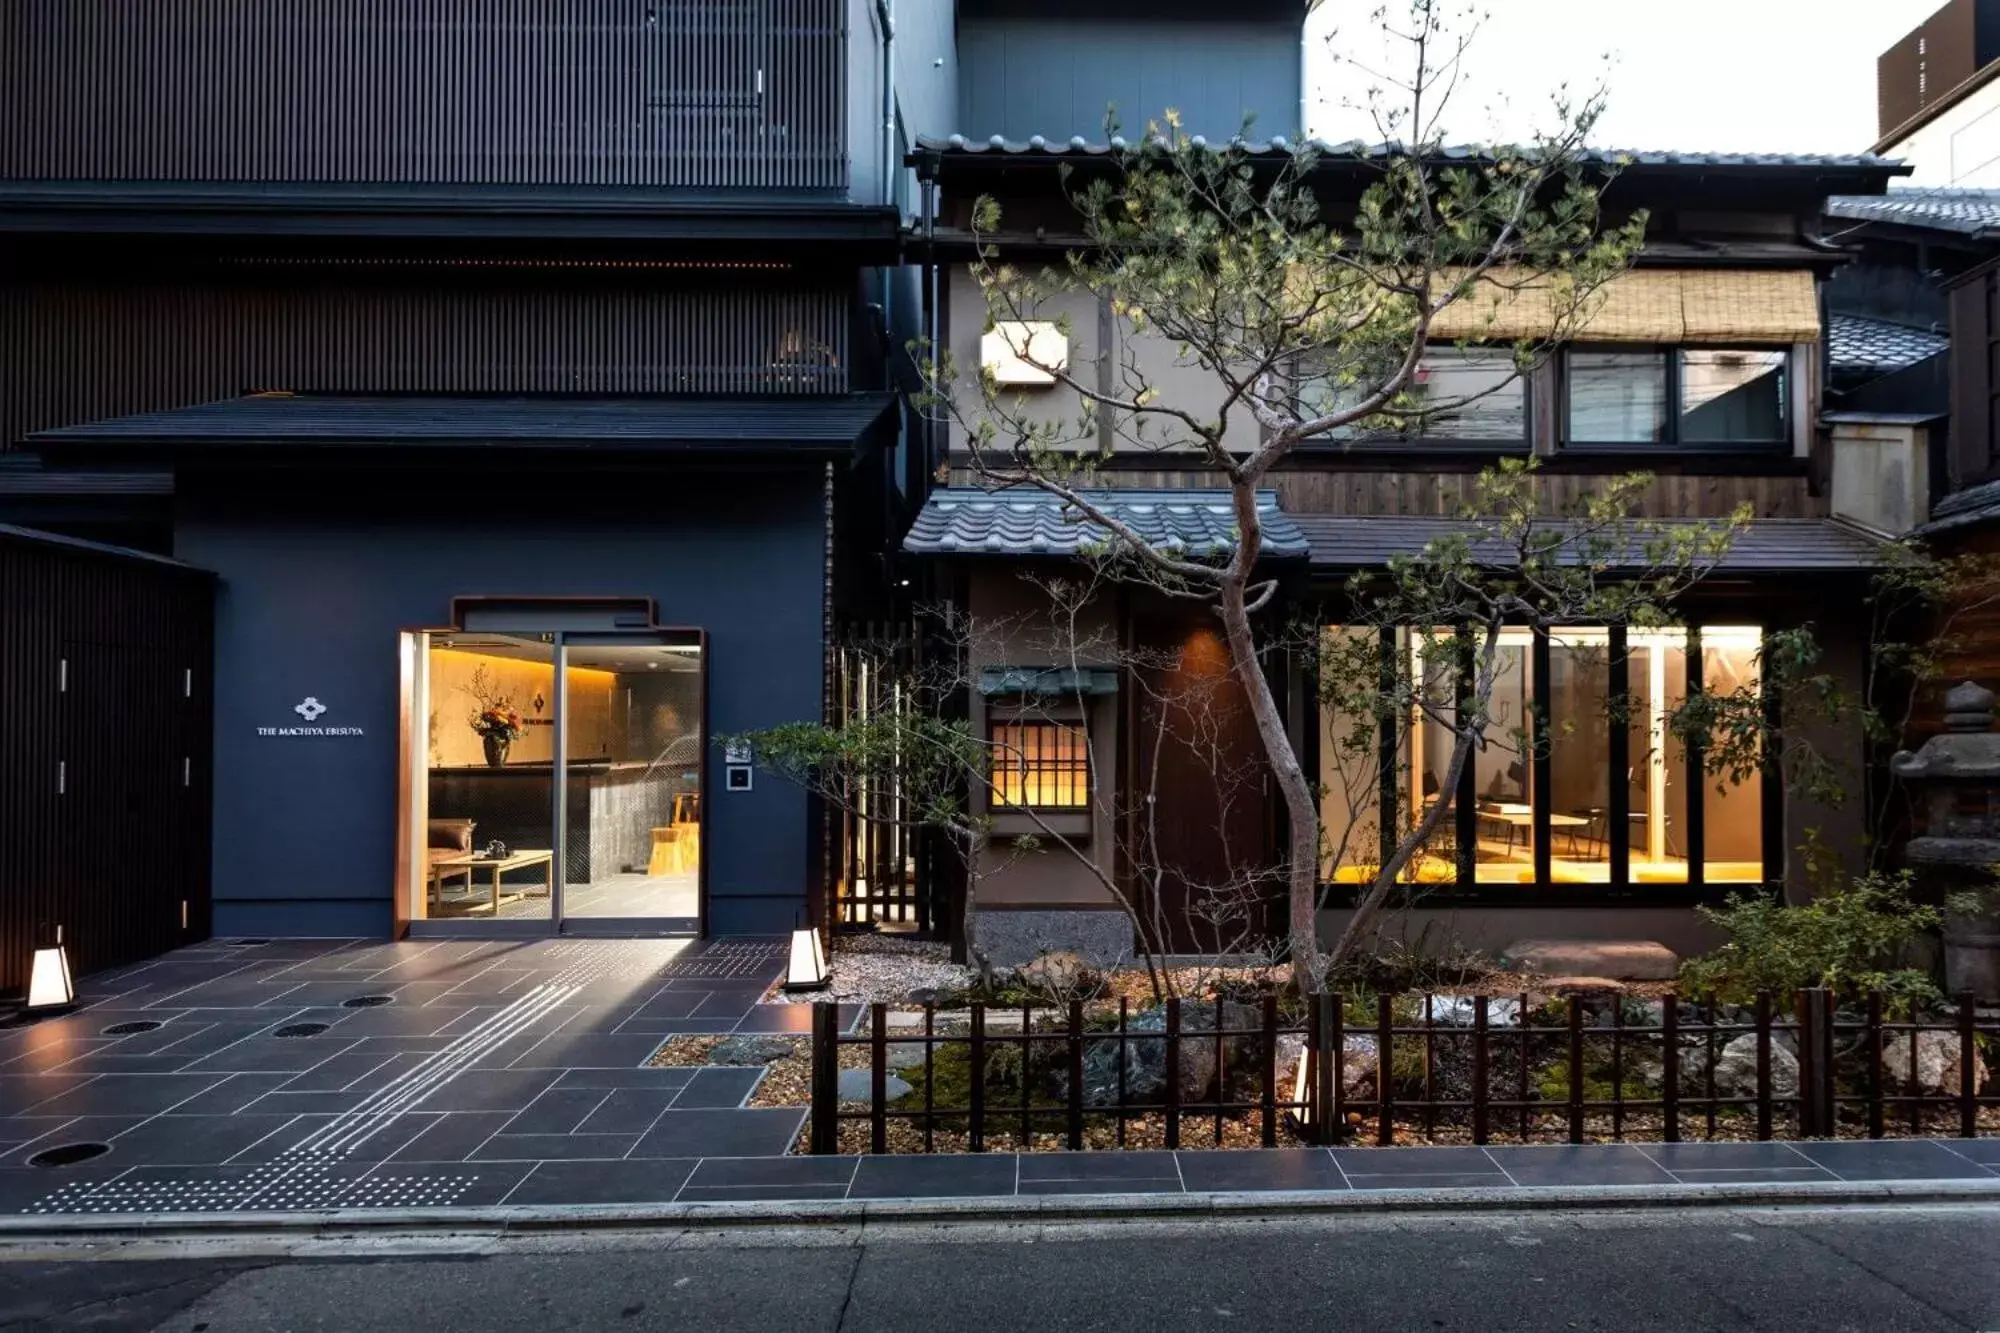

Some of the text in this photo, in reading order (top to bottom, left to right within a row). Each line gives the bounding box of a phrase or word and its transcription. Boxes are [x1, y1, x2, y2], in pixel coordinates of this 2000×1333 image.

[257, 727, 364, 736] THE MACHIYA EBISUYA
